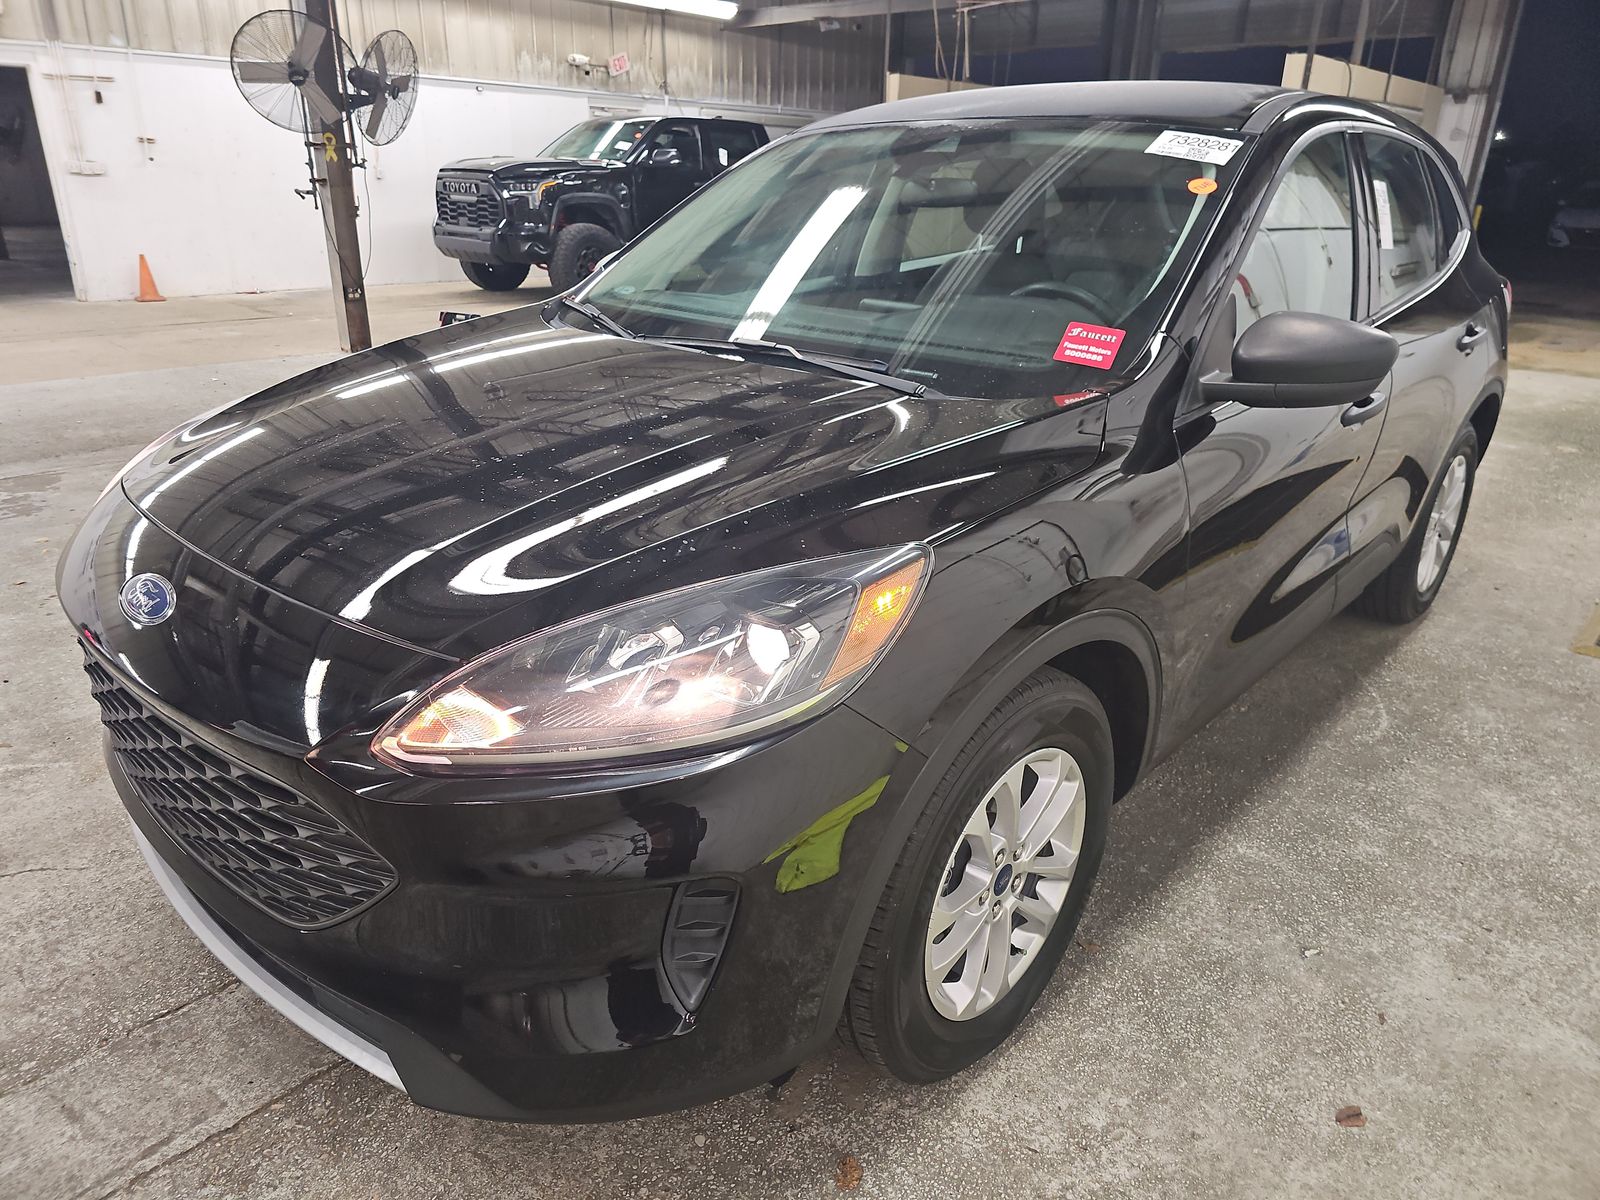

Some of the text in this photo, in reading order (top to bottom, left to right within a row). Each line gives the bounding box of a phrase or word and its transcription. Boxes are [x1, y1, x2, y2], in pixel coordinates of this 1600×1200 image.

[1168, 134, 1240, 153] 7328281
[445, 182, 477, 194] TOYOTA
[1067, 327, 1117, 343] Faucett
[1063, 341, 1112, 356] Faucett Motors
